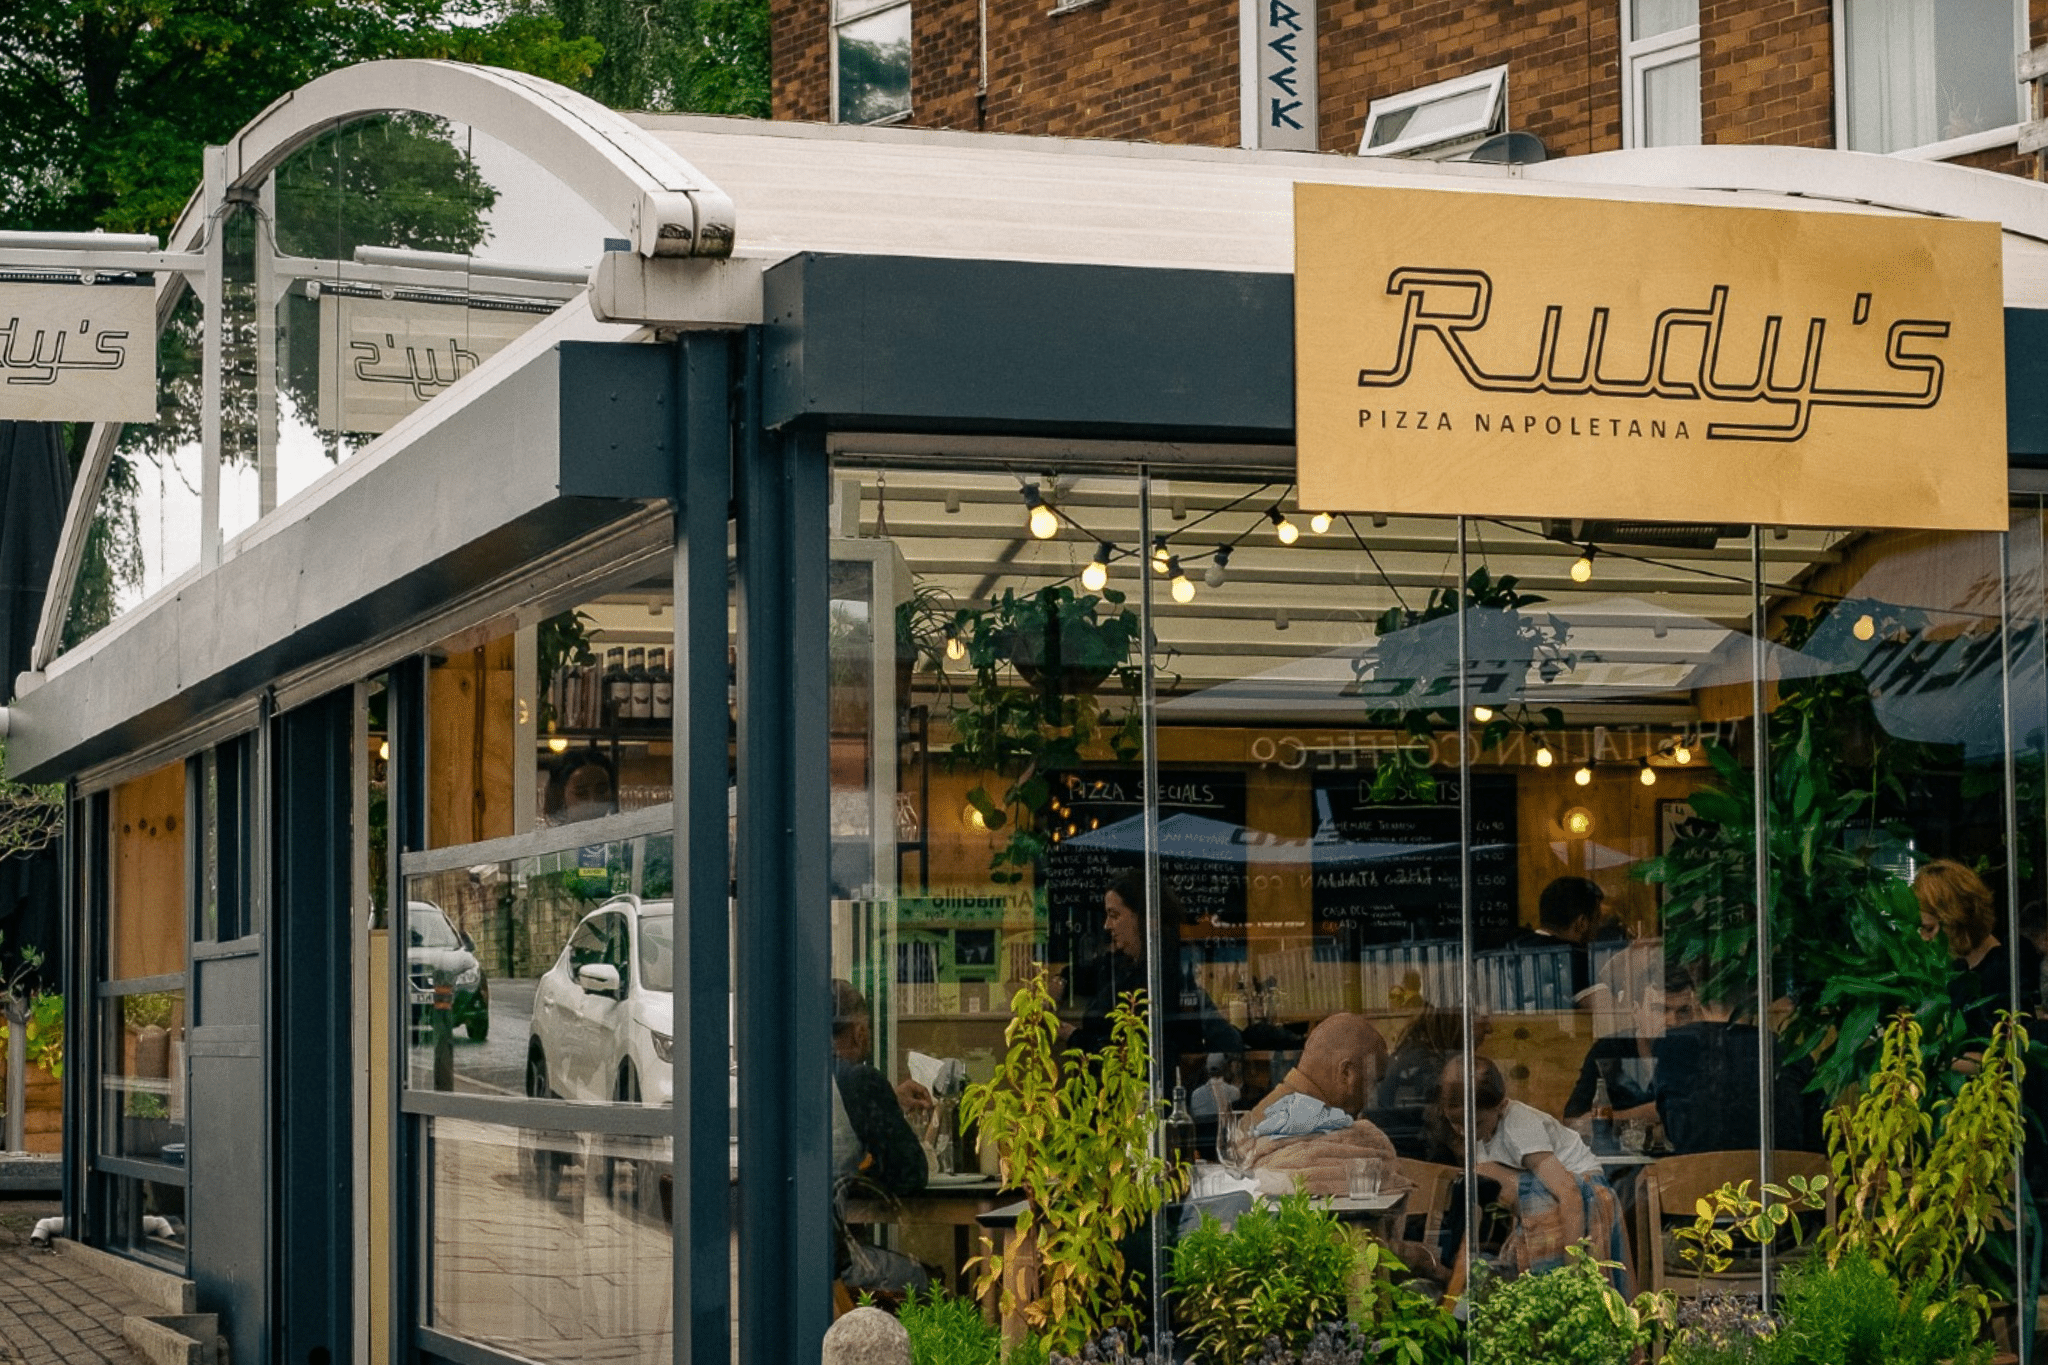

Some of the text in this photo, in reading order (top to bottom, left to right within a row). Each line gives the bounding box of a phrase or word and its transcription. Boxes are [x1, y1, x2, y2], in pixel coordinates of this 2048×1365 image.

[1357, 265, 1952, 443] Rudy's
[1358, 408, 1691, 440] PIZZA NAPOLETANA
[1068, 776, 1215, 803] PIZZA SECIALS
